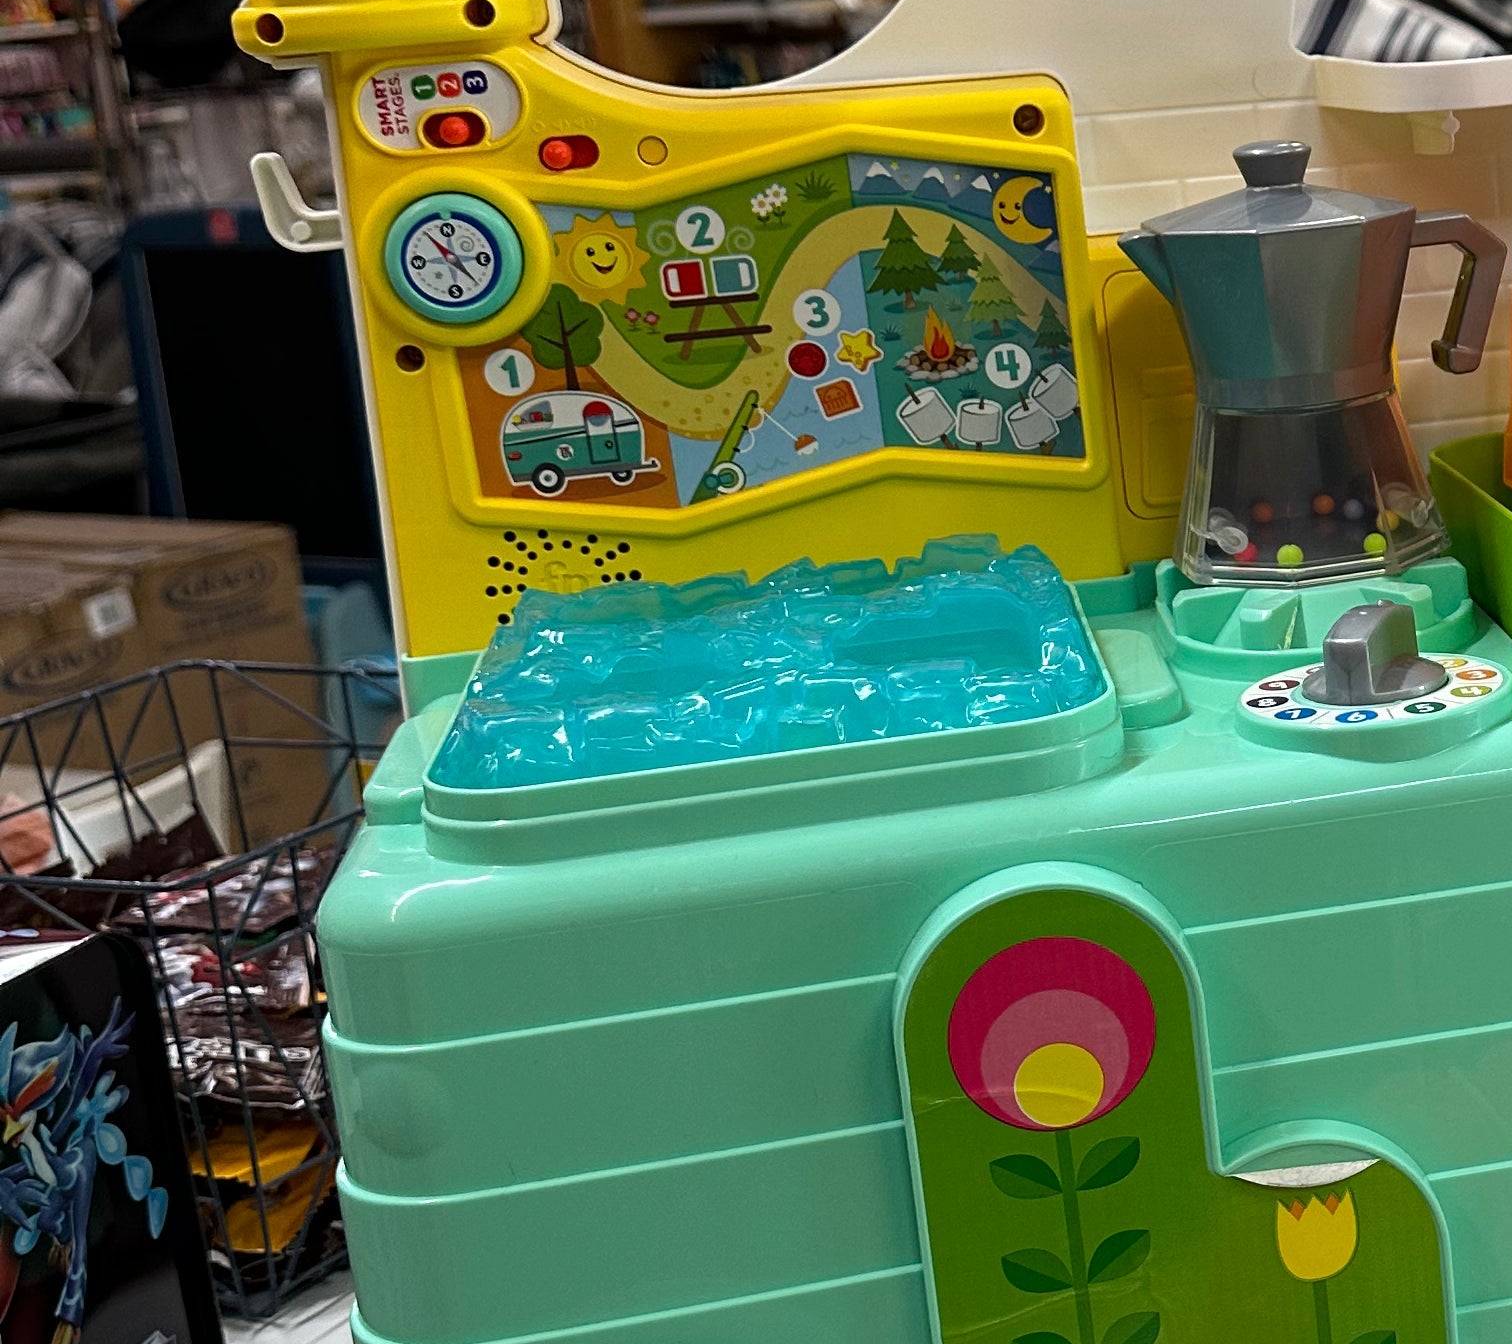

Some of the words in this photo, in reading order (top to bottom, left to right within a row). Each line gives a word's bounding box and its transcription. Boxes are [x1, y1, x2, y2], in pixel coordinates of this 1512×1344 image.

[372, 77, 394, 136] SMART
[687, 212, 714, 247] 2
[805, 296, 830, 329] 3
[500, 355, 520, 388] 1
[995, 349, 1021, 381] 4
